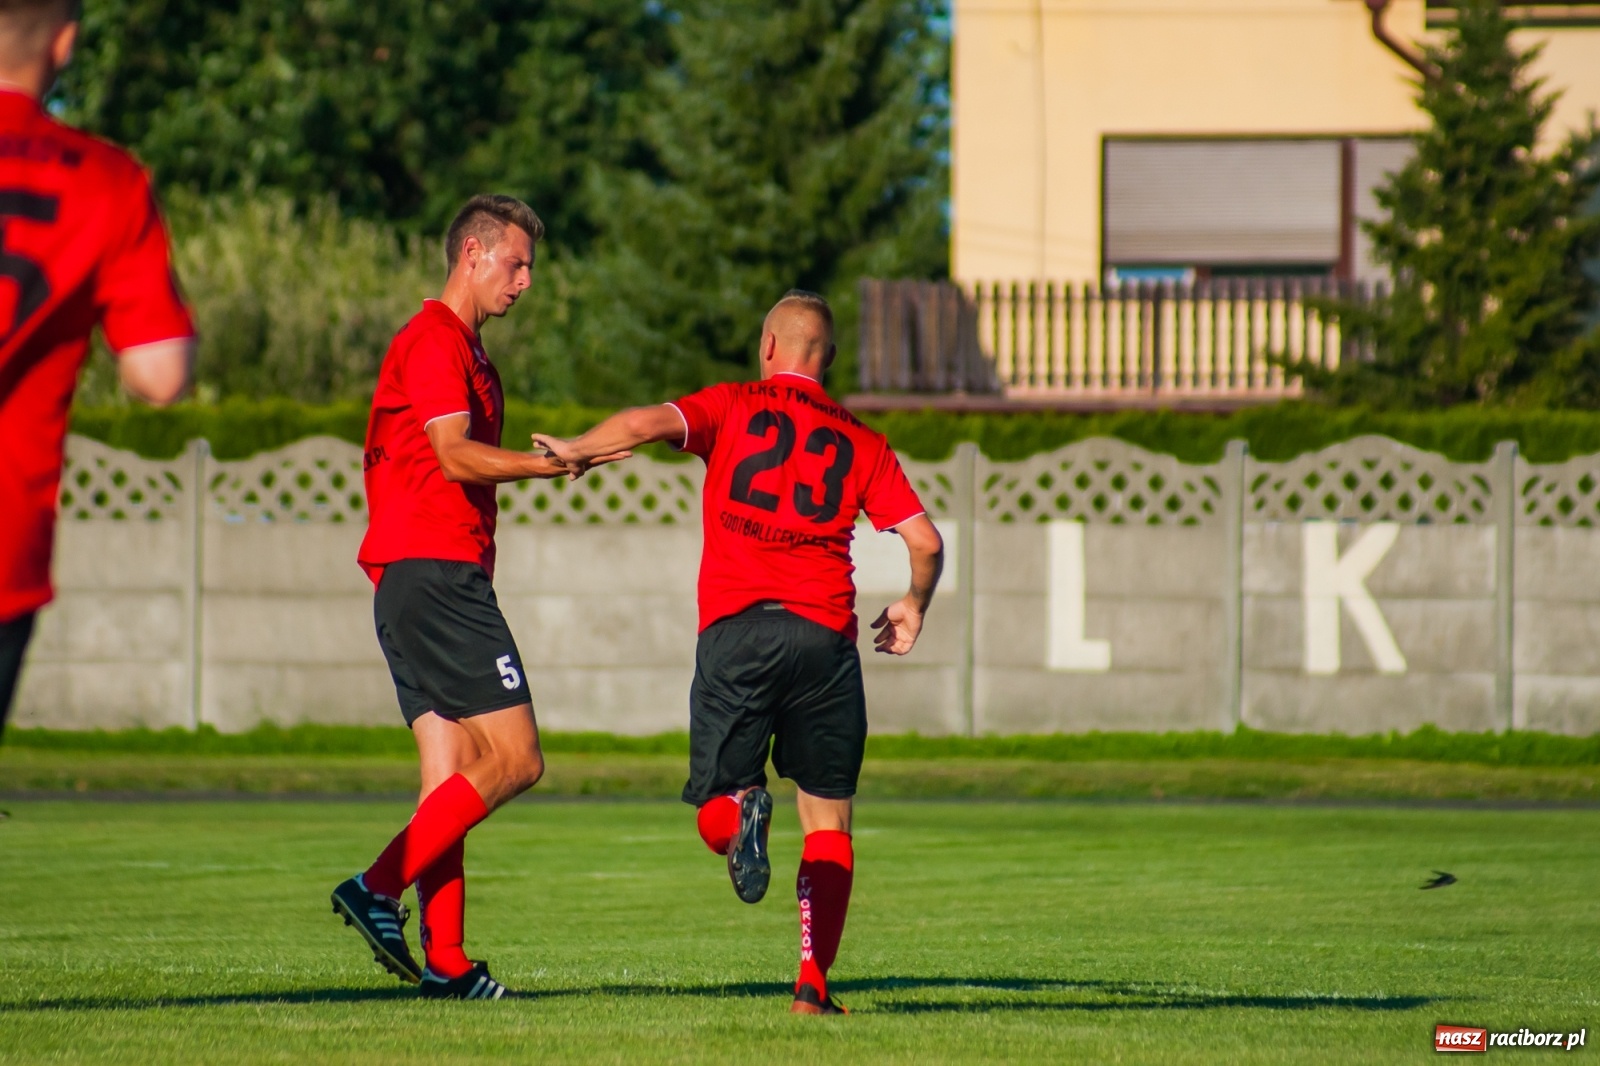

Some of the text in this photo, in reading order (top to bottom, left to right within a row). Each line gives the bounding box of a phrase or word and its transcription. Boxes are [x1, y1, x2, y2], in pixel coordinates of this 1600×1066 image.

[748, 384, 778, 399] LKS
[729, 407, 855, 524] 23
[495, 654, 521, 690] 5
